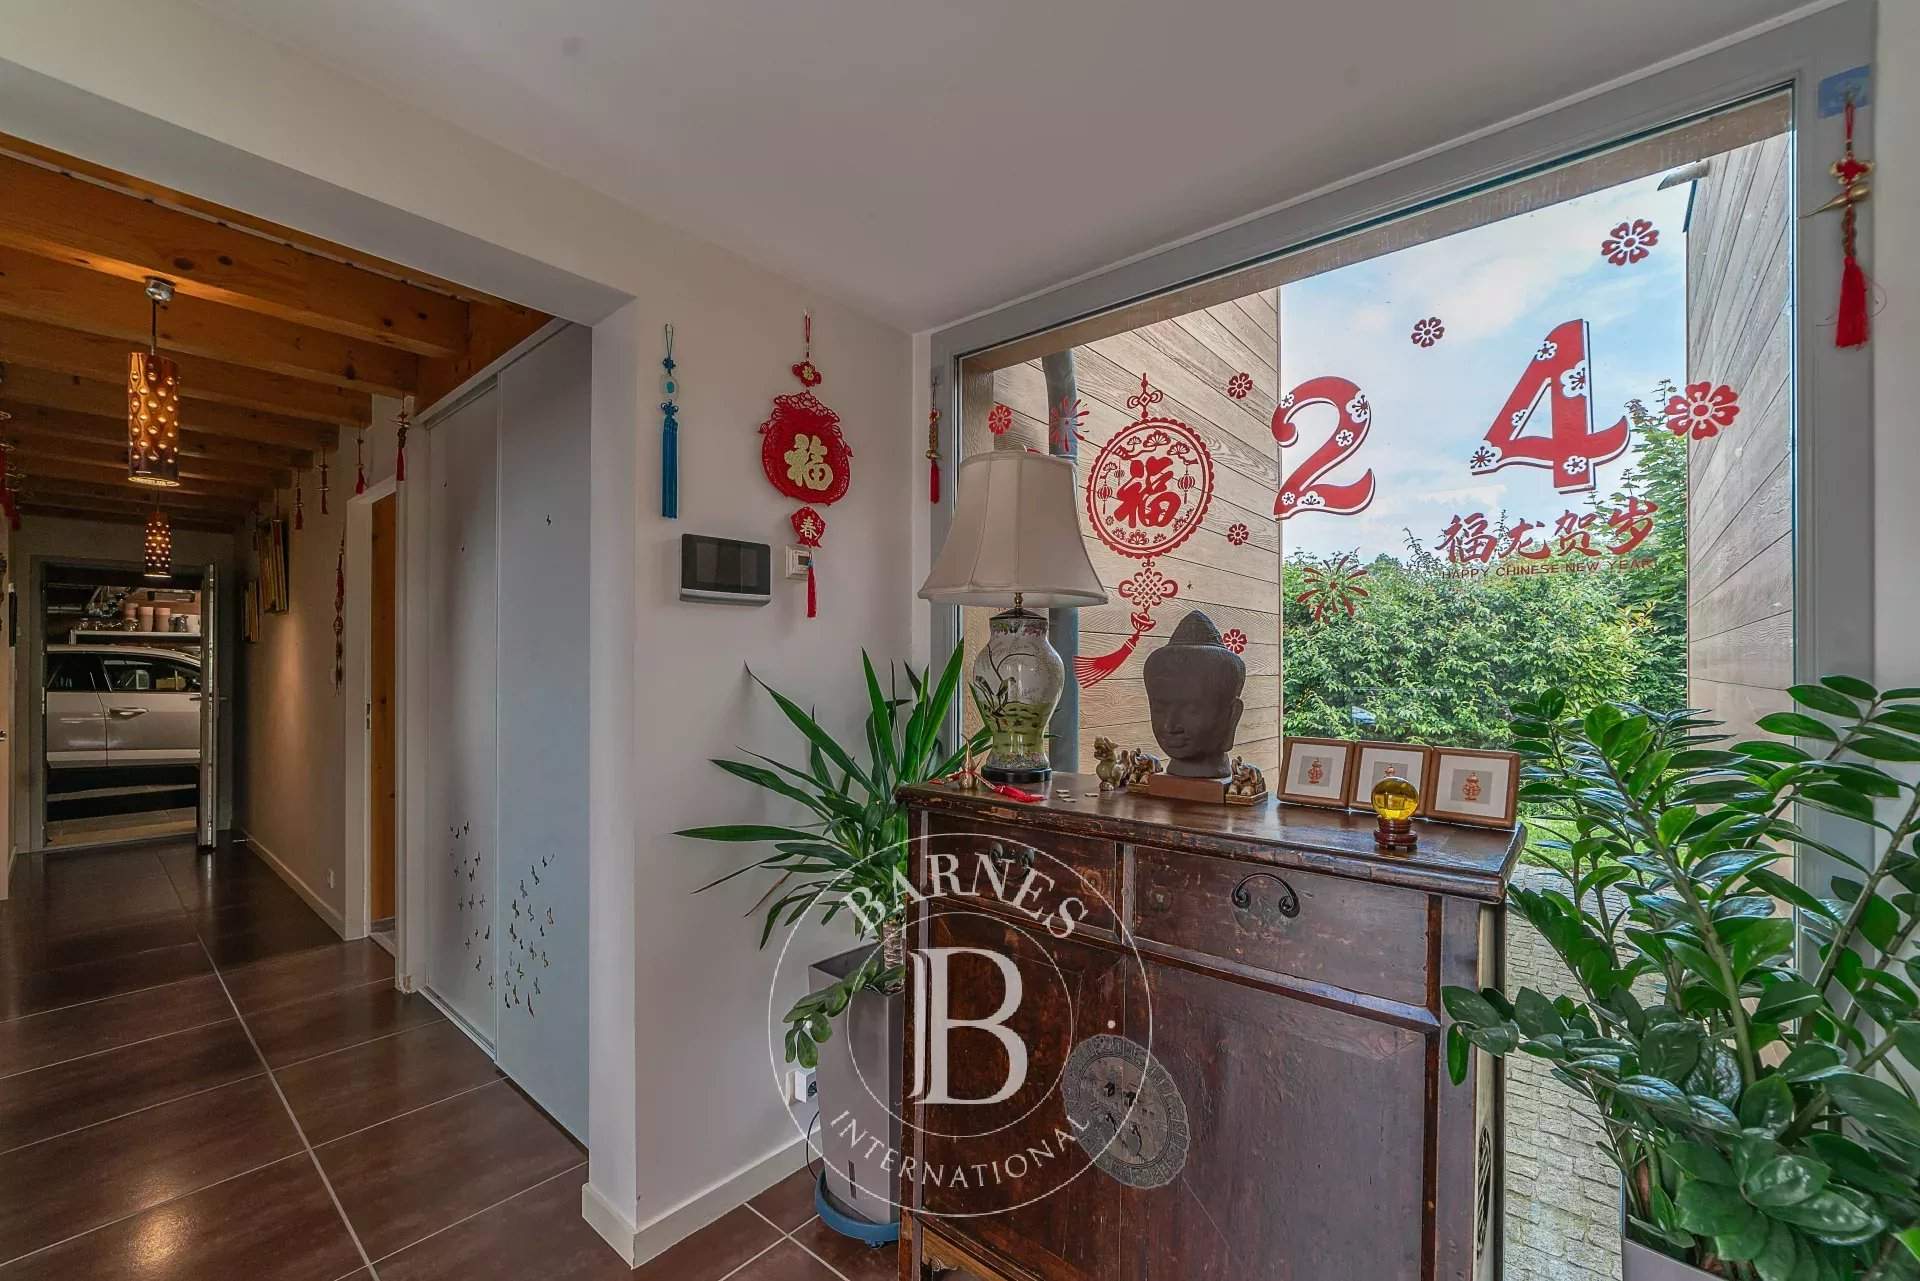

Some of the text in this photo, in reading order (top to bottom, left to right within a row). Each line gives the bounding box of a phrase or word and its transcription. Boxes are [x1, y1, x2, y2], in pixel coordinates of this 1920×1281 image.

[1271, 318, 1631, 520] 2 4
[783, 433, 834, 491] 福
[1113, 456, 1182, 529] 福
[800, 516, 818, 540] 春
[1434, 495, 1659, 564] 福龙贺岁
[1442, 558, 1654, 580] HAPPY CHINESE NEW YEAR
